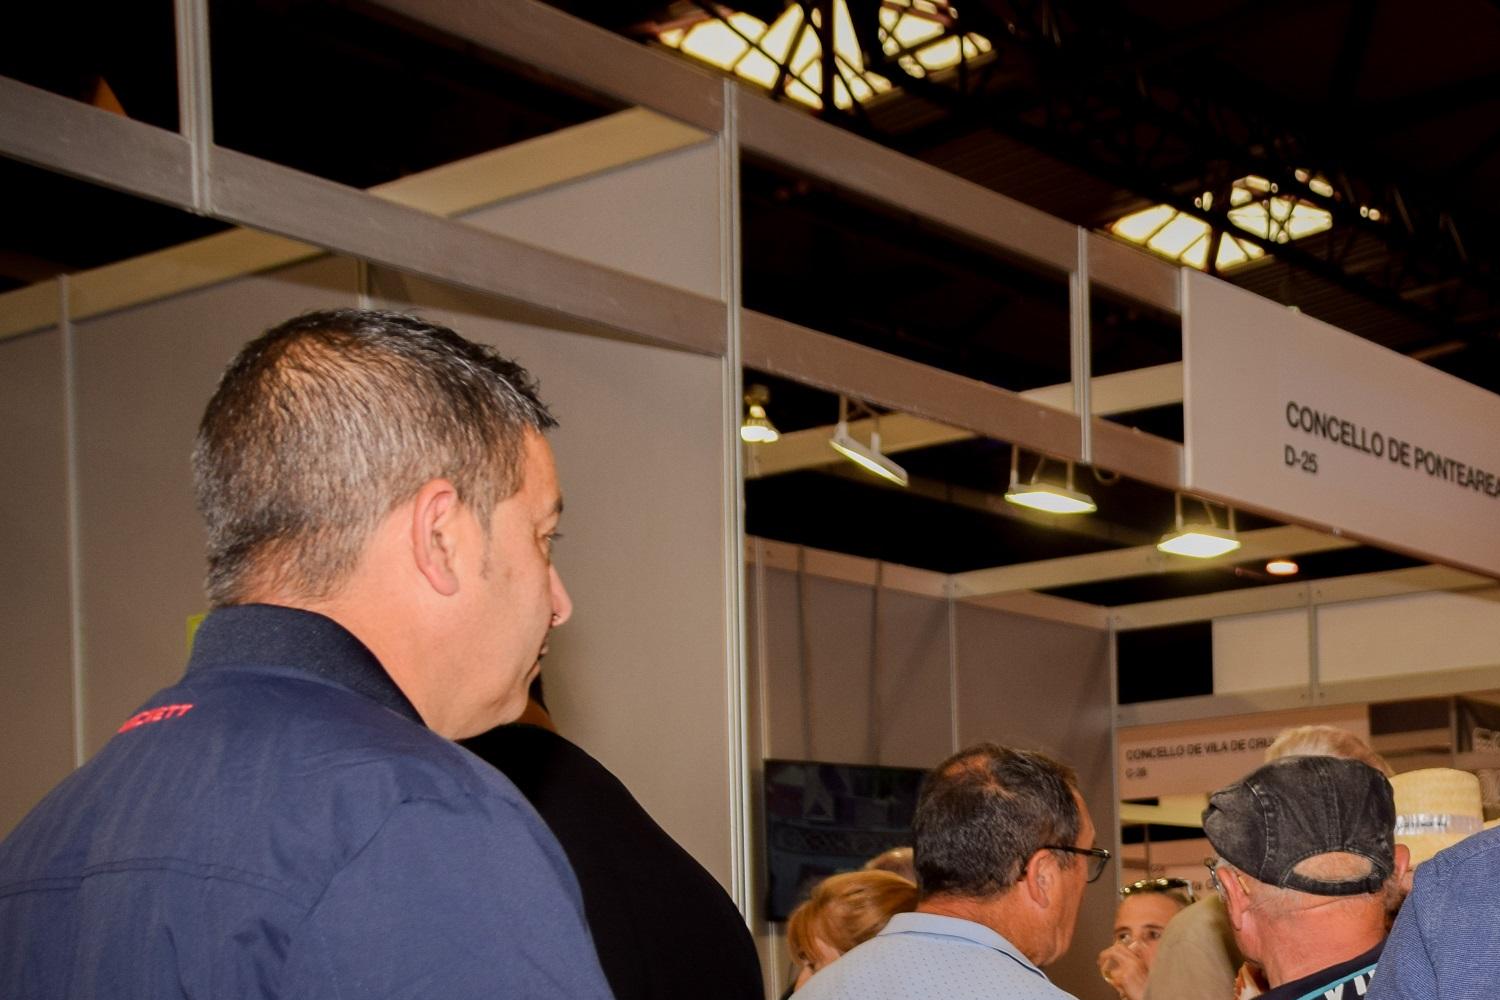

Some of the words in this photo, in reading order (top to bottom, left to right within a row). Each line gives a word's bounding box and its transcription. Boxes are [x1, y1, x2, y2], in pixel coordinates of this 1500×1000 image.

[1286, 400, 1385, 458] CONCELLO
[1388, 436, 1411, 468] DE
[1284, 444, 1318, 473] D-25
[1126, 744, 1185, 761] CONCELLO
[1187, 743, 1202, 756] DE
[1205, 741, 1228, 754] VILA
[1230, 738, 1247, 751] DE
